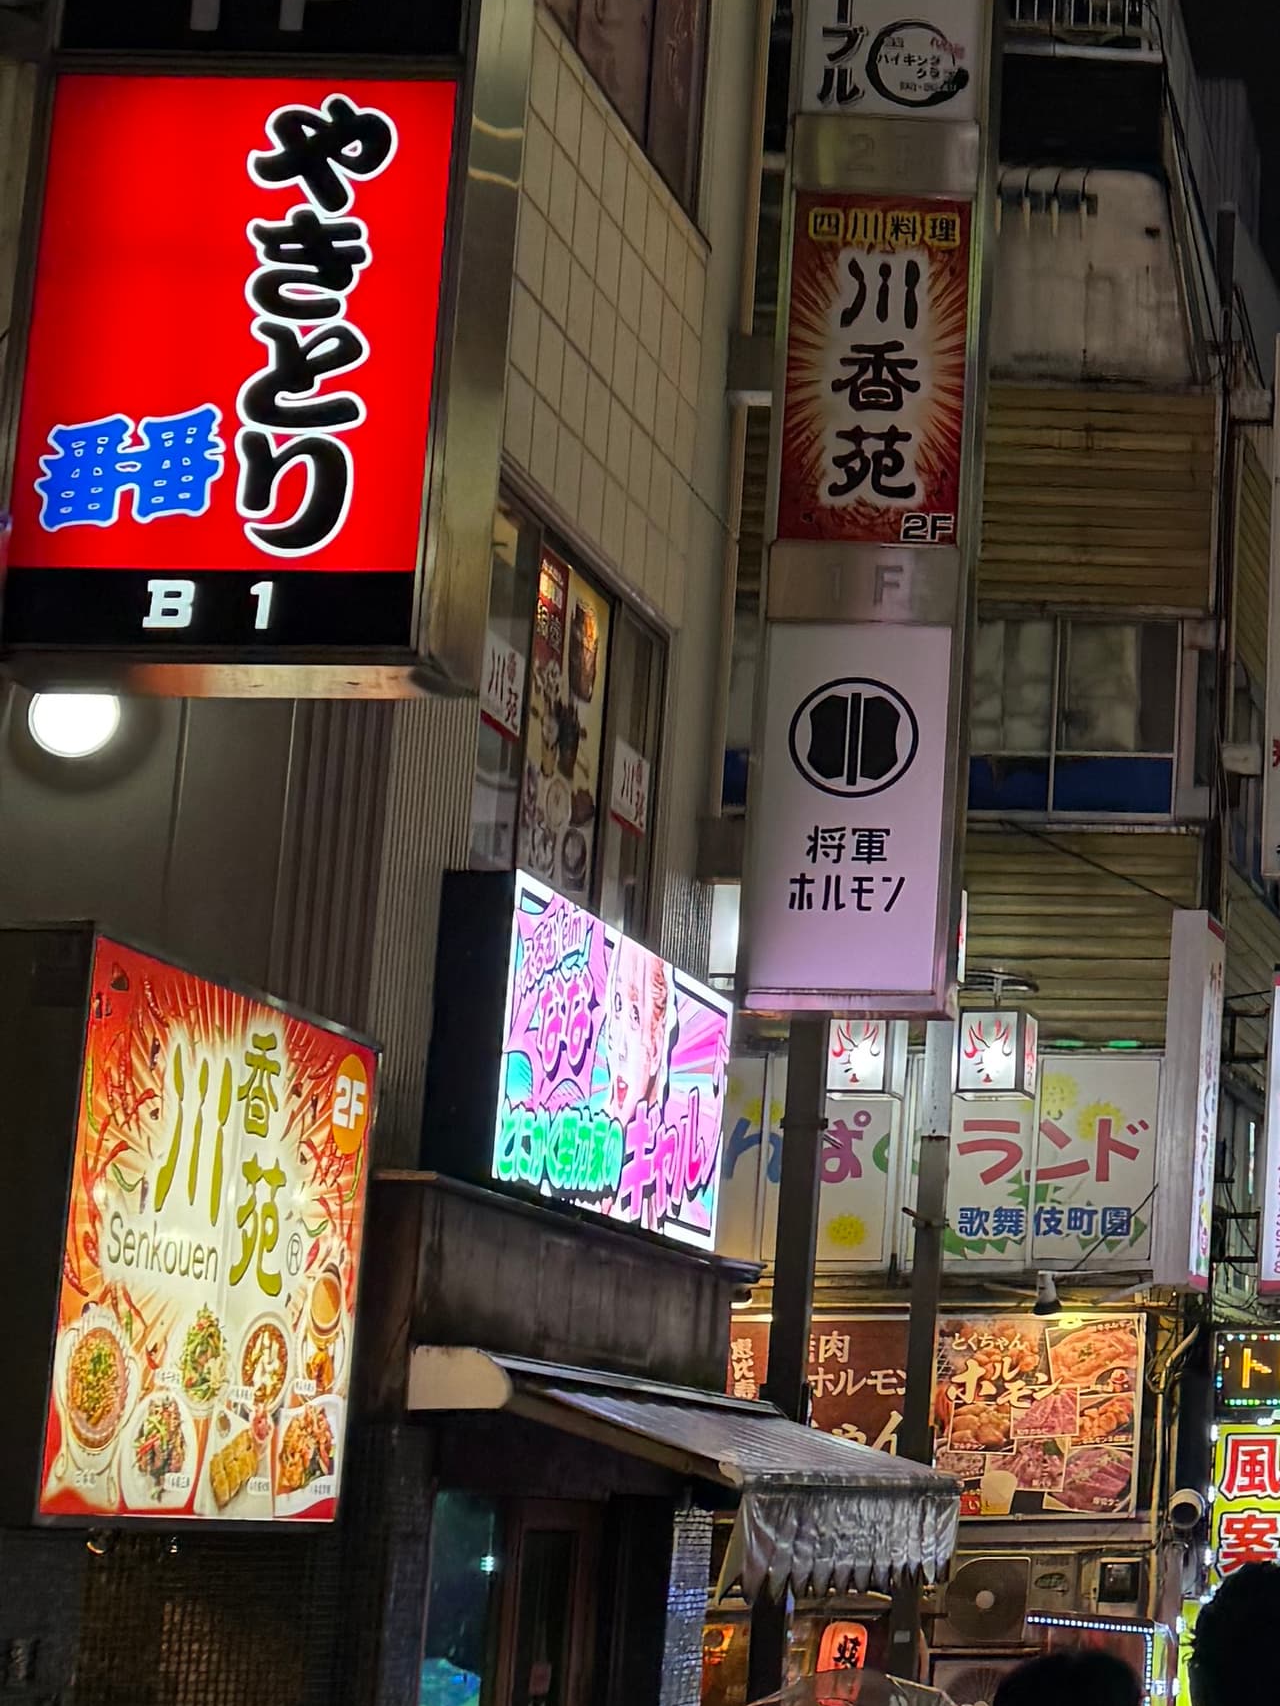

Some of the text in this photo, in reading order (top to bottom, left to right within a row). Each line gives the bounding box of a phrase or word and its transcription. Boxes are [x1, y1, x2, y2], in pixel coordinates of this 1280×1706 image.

[809, 207, 960, 249] 四川料理
[236, 93, 397, 559] やきとり
[828, 257, 922, 501] 川香苑
[901, 513, 955, 542] 2F
[805, 826, 892, 864] 将軍
[789, 874, 904, 912] ホルモン
[331, 1077, 366, 1131] 2F
[958, 1206, 1133, 1238] 歌舞伎町園
[106, 1212, 219, 1283] Senkouen
[952, 1334, 1025, 1351] とくちゃん
[947, 1357, 1064, 1407] ホルモン
